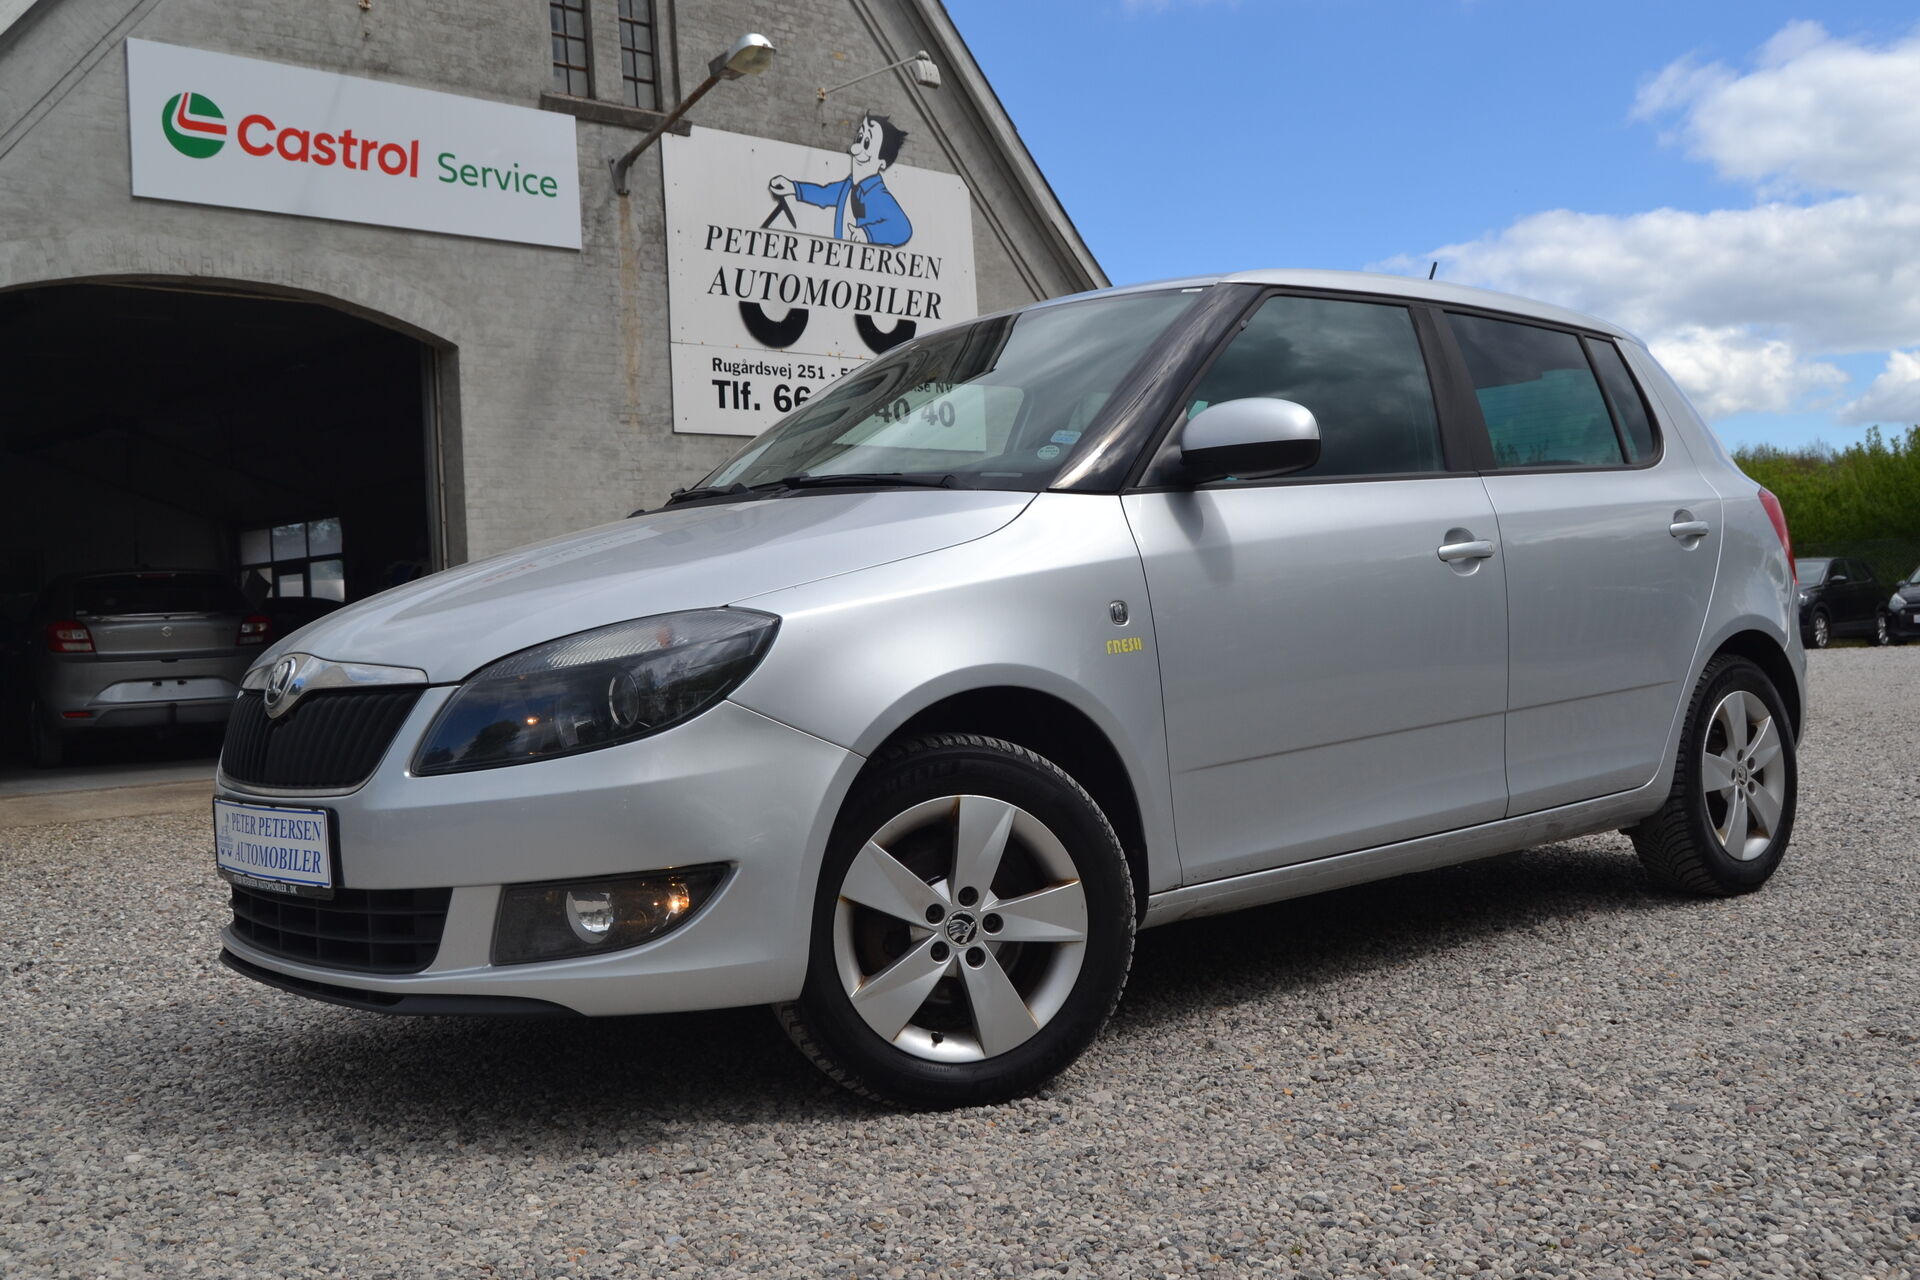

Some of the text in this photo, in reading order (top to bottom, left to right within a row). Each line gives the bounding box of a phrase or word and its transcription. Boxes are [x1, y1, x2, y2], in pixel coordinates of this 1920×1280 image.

[237, 114, 558, 198] Castrol Service
[704, 224, 943, 280] PETER PETERSEN
[707, 266, 943, 320] AUTOMOBILER
[712, 357, 792, 380] Rugårdsvej
[797, 364, 825, 380] 251
[712, 379, 760, 411] Tlf.
[921, 401, 955, 427] 40
[1106, 637, 1142, 655] FRESH
[231, 812, 322, 841] PETER PETERSEN
[235, 841, 322, 873] AUTOMOBILER
